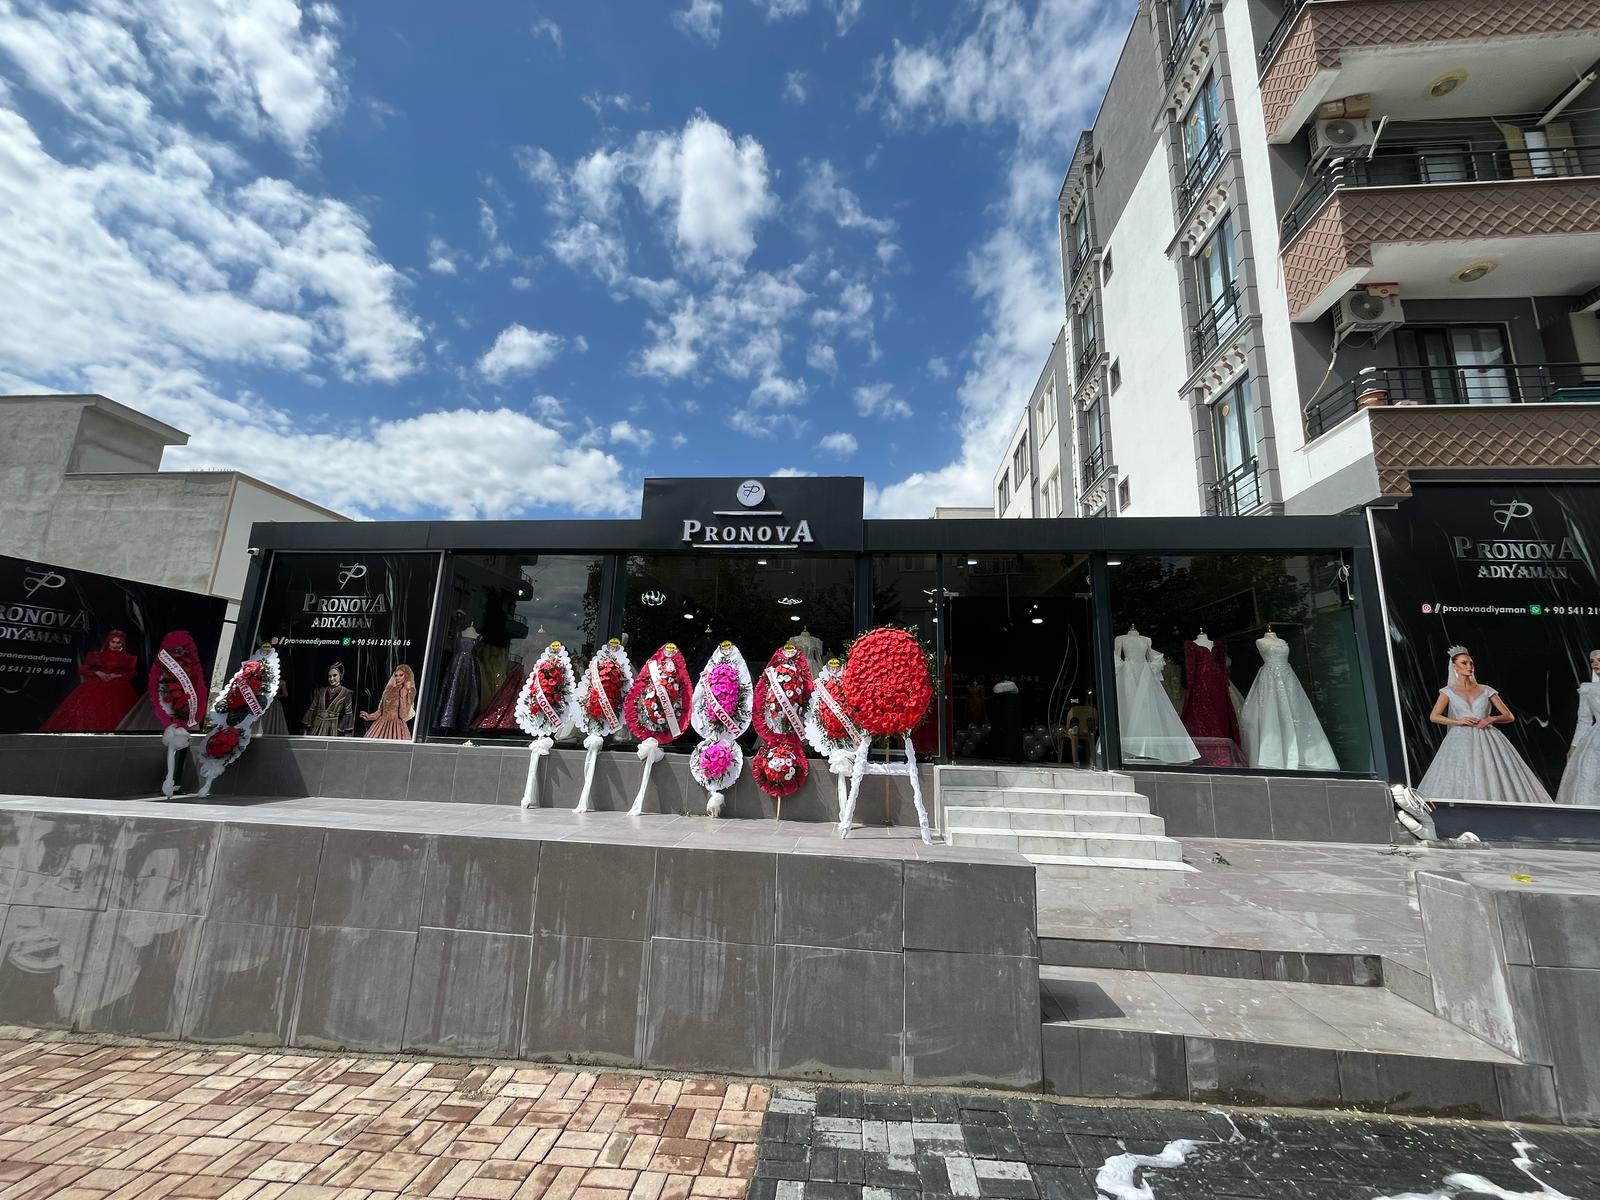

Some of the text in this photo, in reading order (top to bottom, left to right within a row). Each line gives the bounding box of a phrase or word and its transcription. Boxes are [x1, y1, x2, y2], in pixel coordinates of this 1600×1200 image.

[681, 520, 814, 543] PRONOVA
[1454, 536, 1581, 559] PRONOVA
[1477, 564, 1568, 579] ADIYAMAN
[302, 593, 388, 612] PRONOVA
[1567, 606, 1584, 615] 541
[1588, 607, 1600, 615] 21
[311, 616, 373, 628] ADIYAMAN
[7, 665, 24, 673] 541
[25, 666, 42, 674] 219
[716, 709, 741, 737] KONYA
